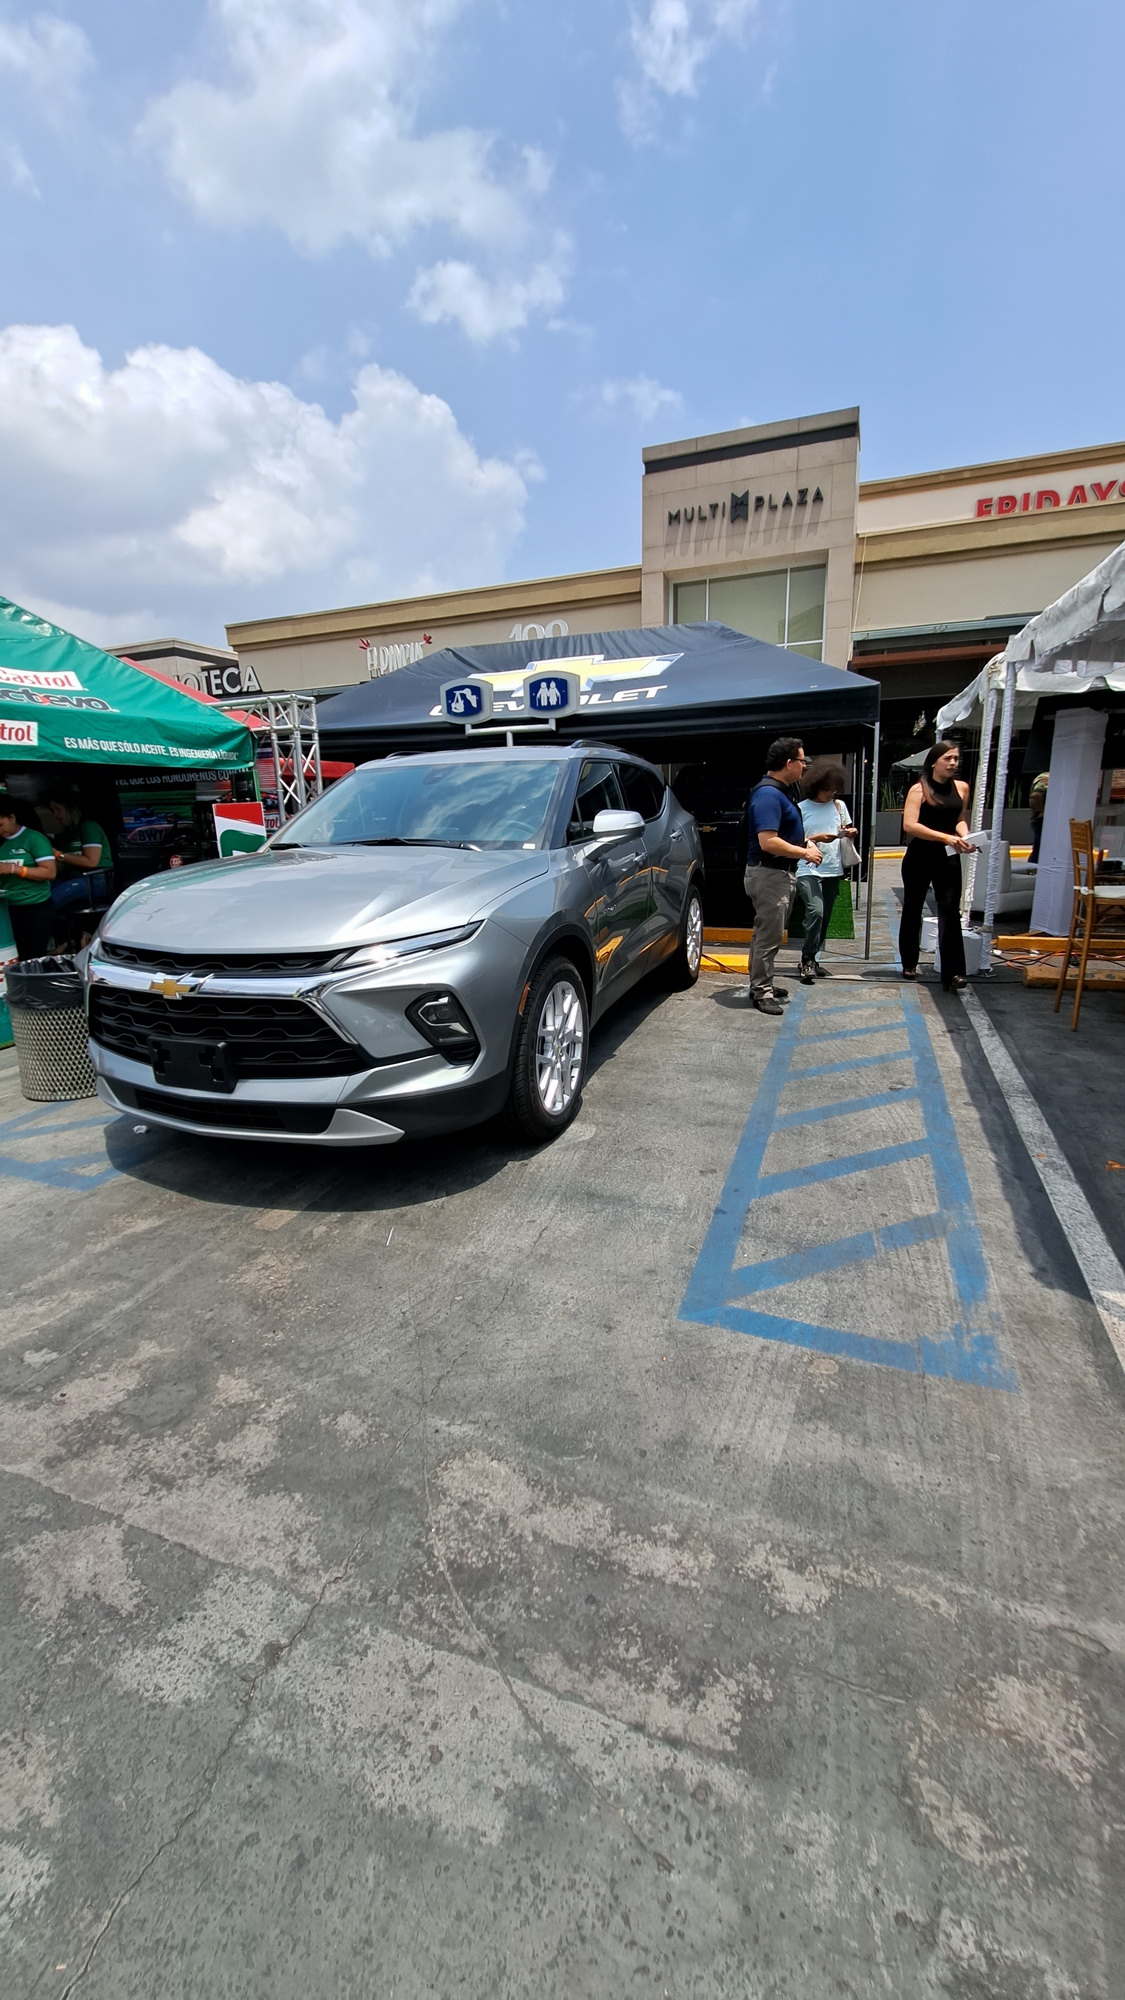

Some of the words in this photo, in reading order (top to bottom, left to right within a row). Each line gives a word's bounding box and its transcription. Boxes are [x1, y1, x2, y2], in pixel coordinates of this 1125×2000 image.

[668, 502, 726, 526] MULTI
[754, 486, 824, 512] PLAZA
[976, 480, 1125, 518] FRIDAY
[173, 665, 262, 696] OTECA
[0, 687, 111, 711] ctevo
[64, 737, 78, 749] ES
[77, 736, 100, 751] MÁS
[100, 739, 119, 752] QUE
[168, 746, 179, 757] ES
[137, 829, 165, 842] BWT
